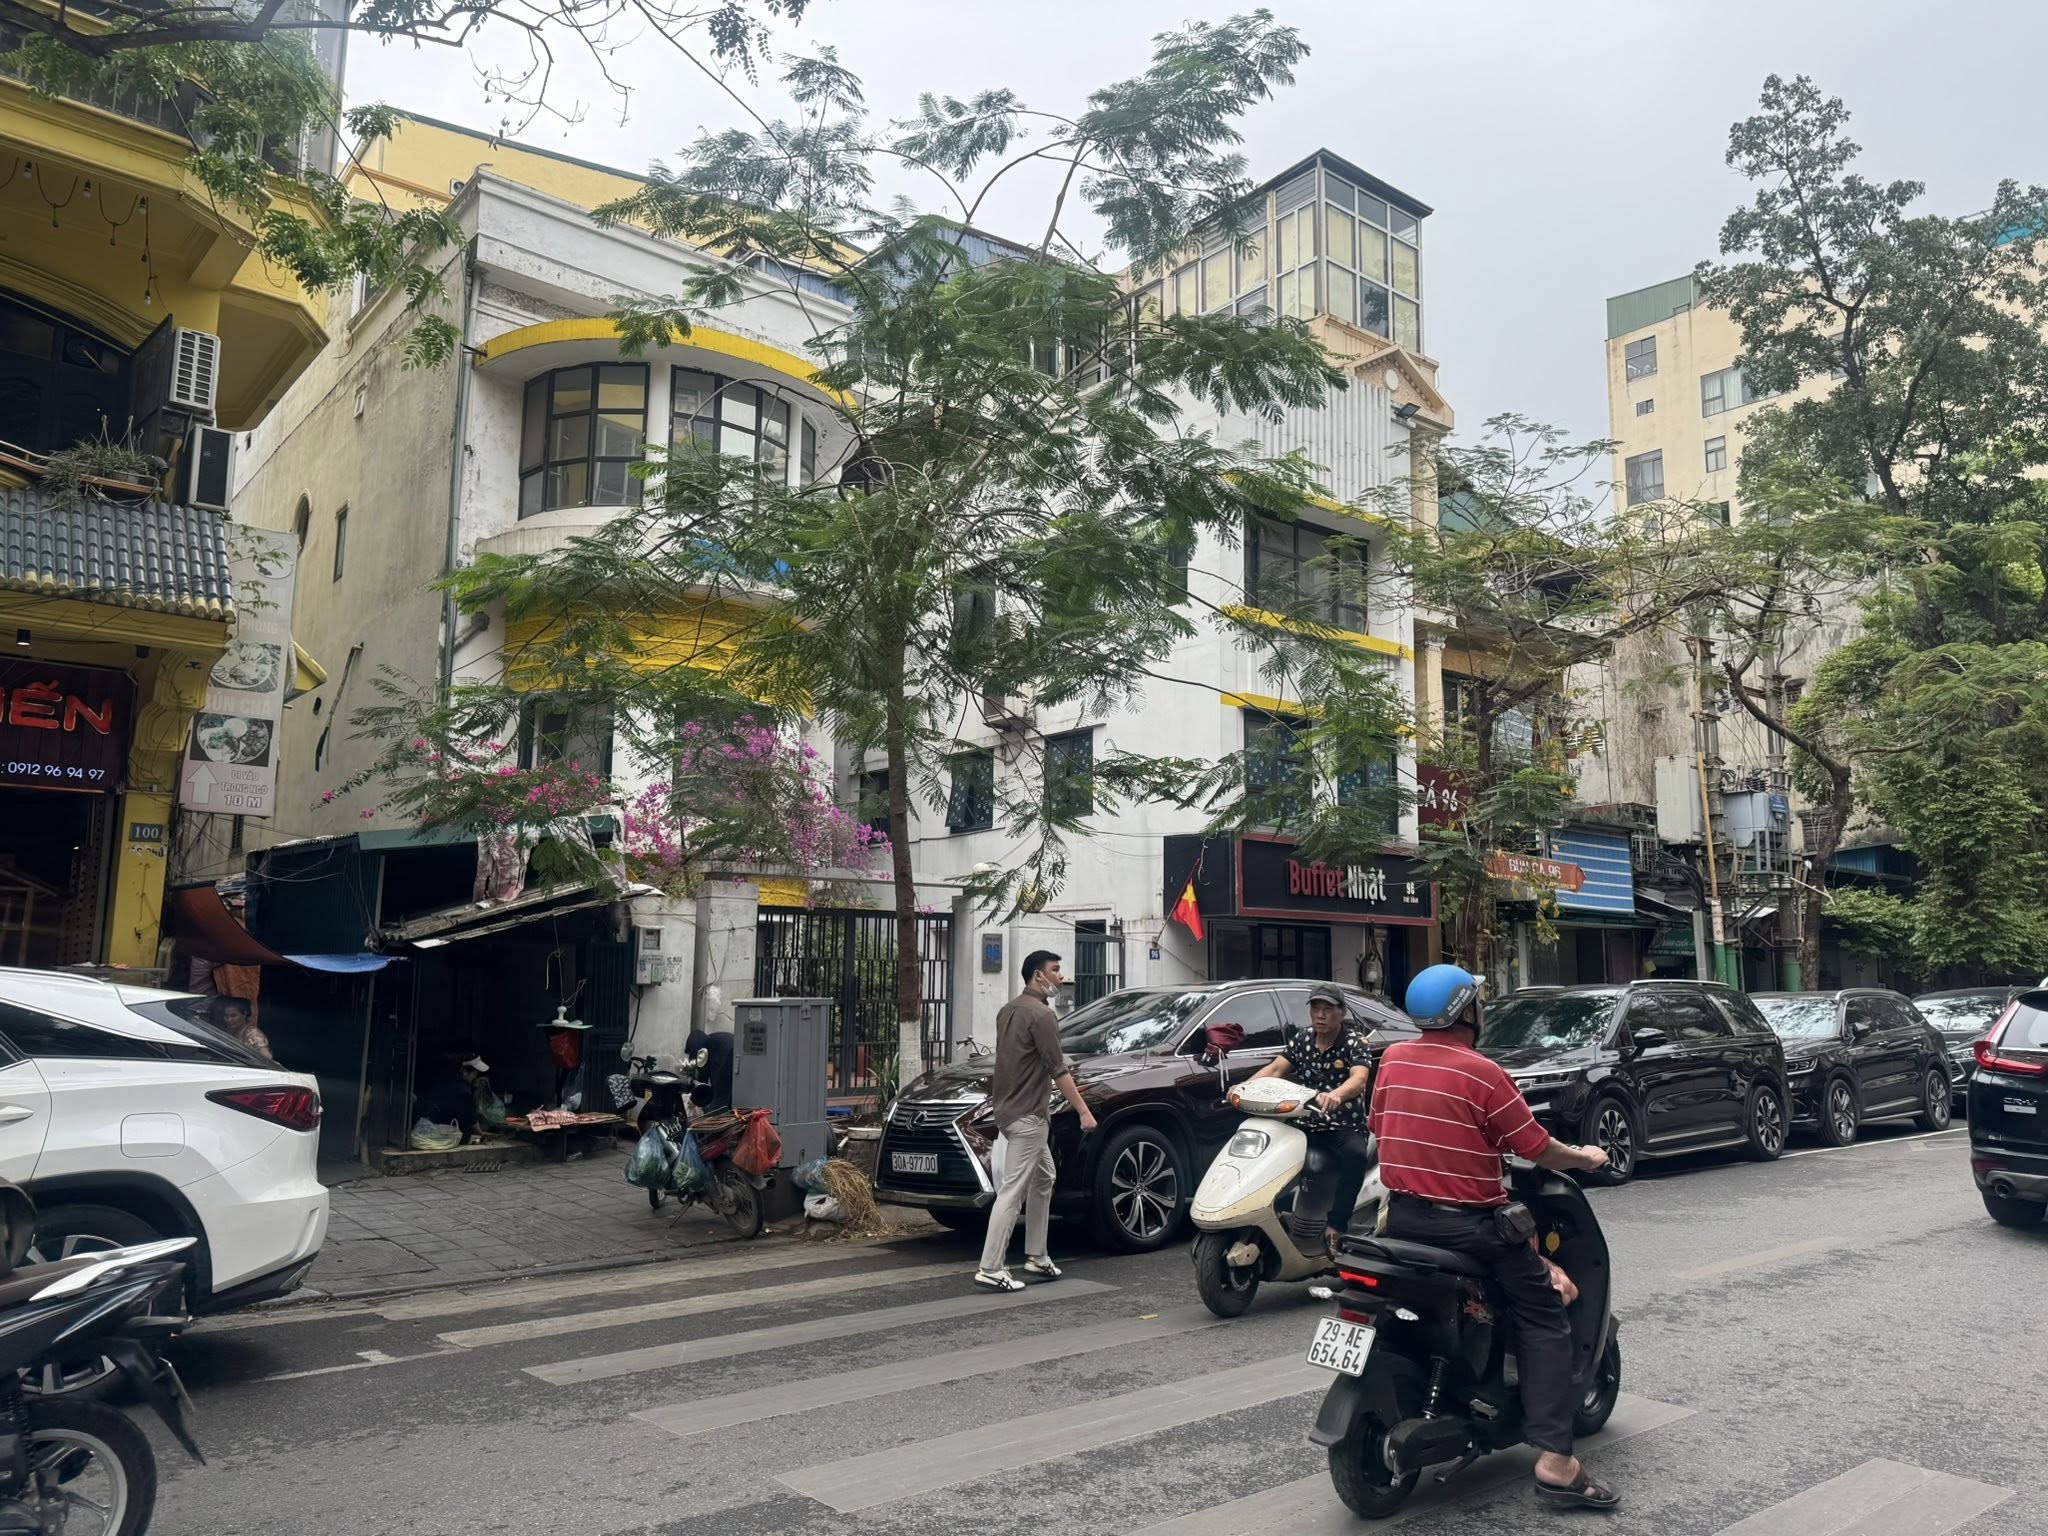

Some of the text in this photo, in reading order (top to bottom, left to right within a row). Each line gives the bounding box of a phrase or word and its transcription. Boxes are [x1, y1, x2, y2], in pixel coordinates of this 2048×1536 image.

[8, 762, 105, 780] 0912 96 94 97
[224, 794, 262, 808] 10 M
[135, 826, 160, 839] 100
[1288, 859, 1387, 906] Buffet Nhật
[1406, 881, 1415, 895] 96
[893, 1154, 936, 1171] 30A-977.00
[1321, 1321, 1366, 1349] 29-AE
[1311, 1341, 1361, 1372] 654.64
